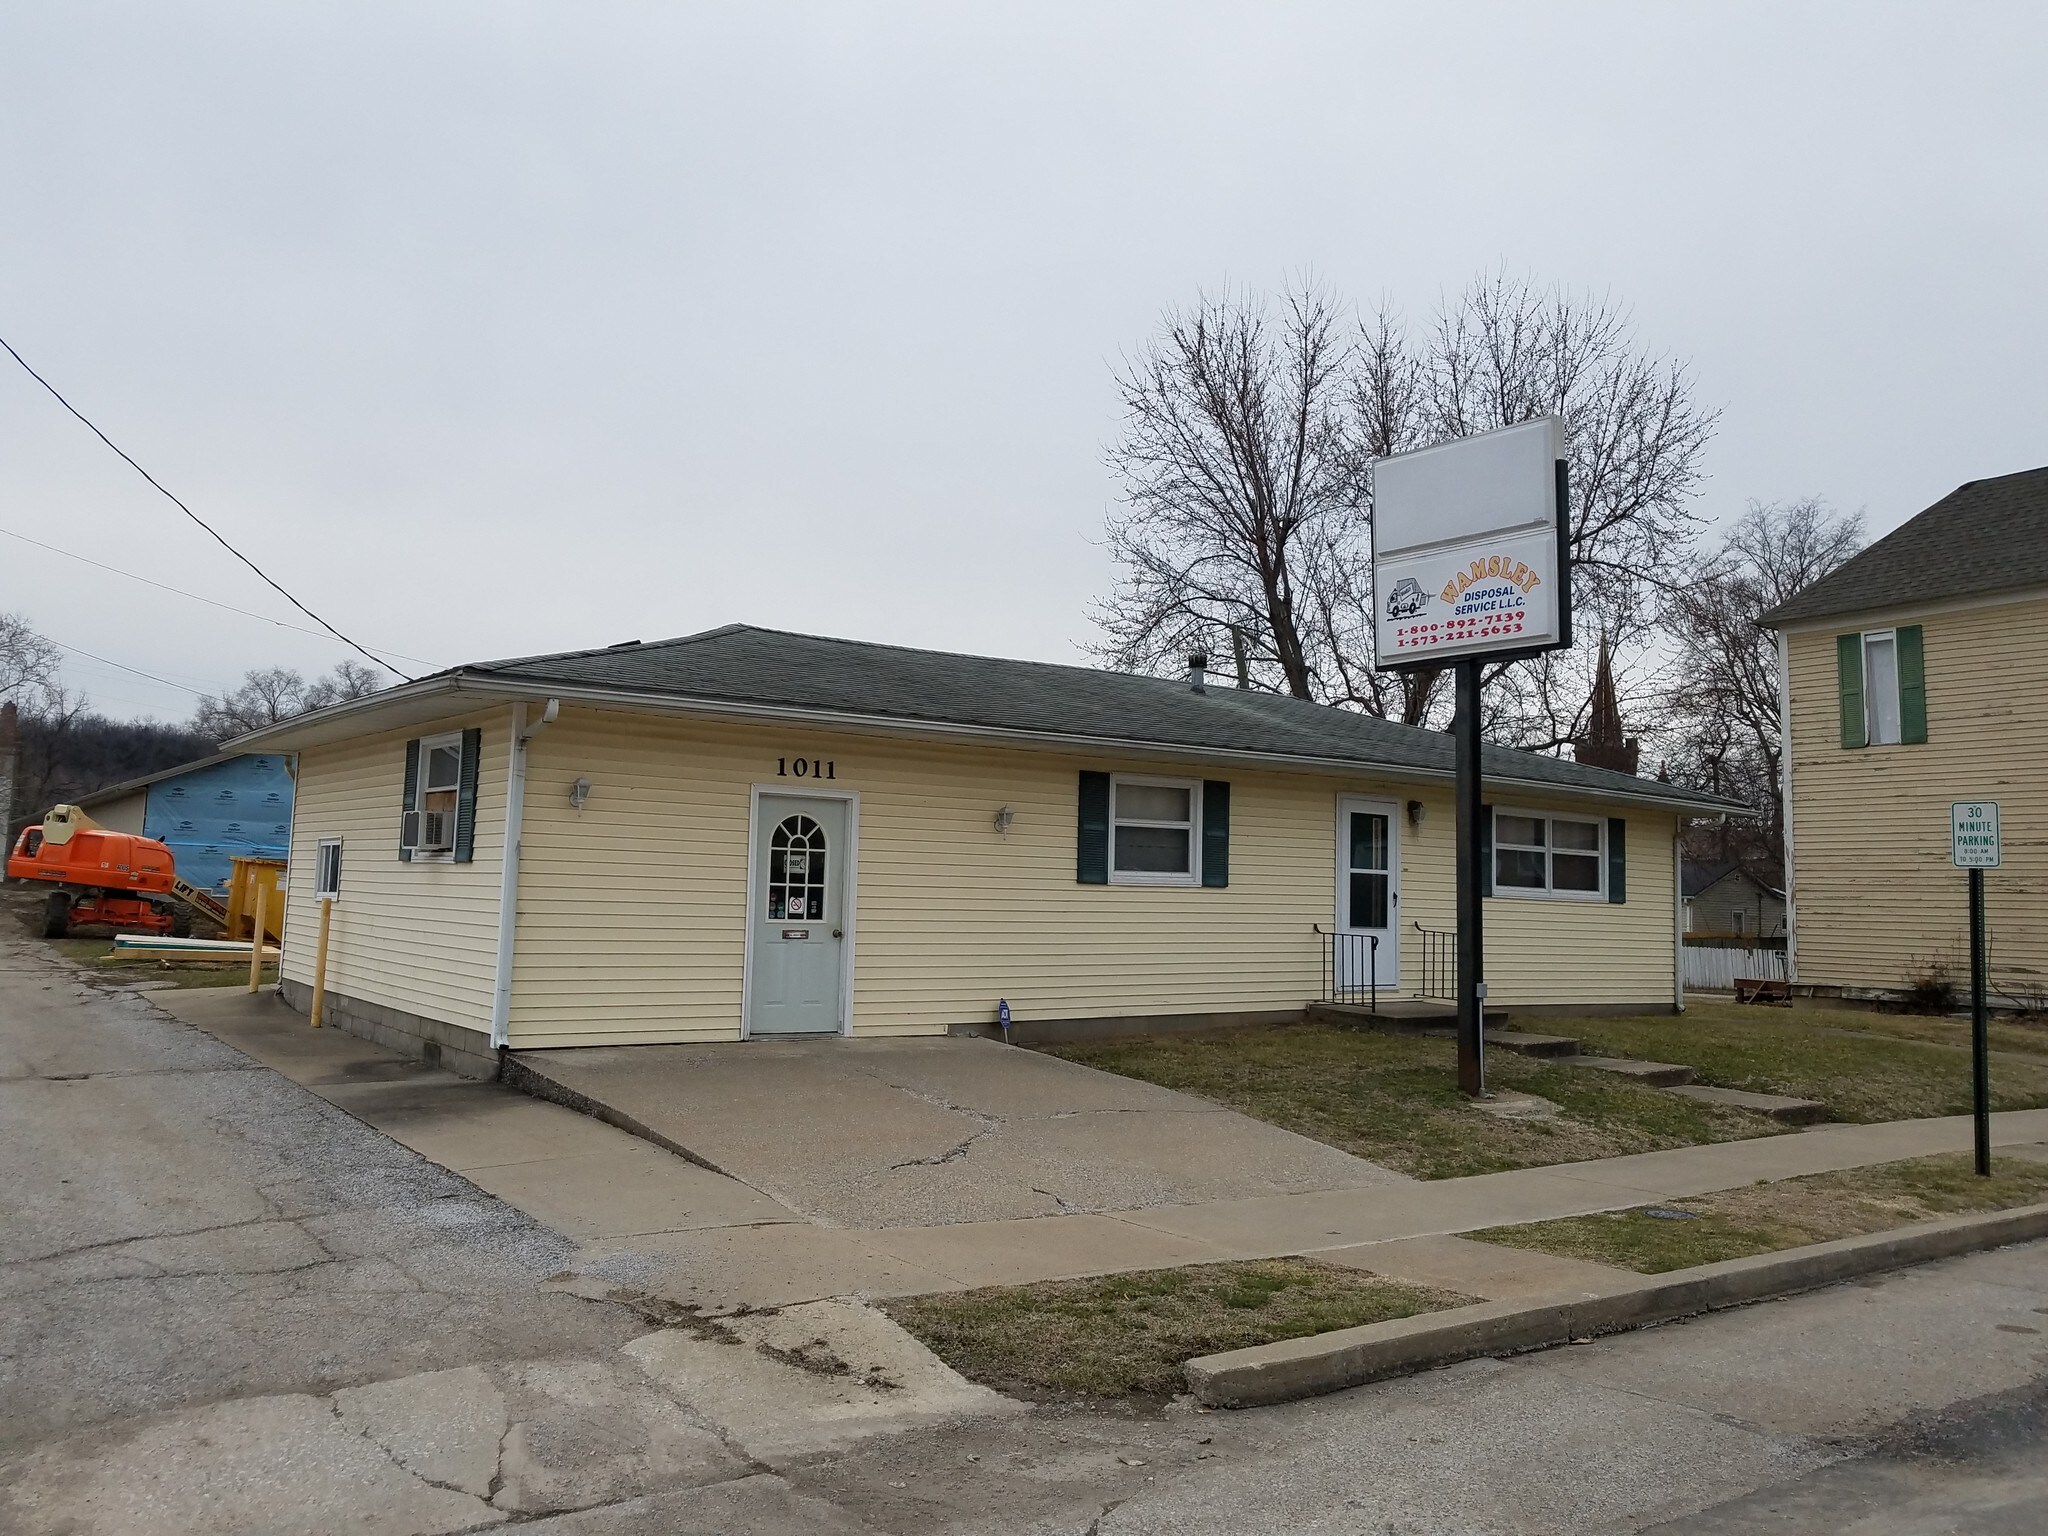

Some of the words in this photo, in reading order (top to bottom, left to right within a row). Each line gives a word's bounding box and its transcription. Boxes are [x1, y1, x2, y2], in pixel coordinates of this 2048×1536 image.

[1440, 556, 1541, 604] WAMSLEY
[1464, 586, 1515, 602] DISPOSAL
[1455, 601, 1497, 616] SERVICE
[1397, 611, 1525, 637] 1-800-892-7139
[1397, 623, 1523, 647] 1-573-221-5653
[777, 757, 836, 780] 1011
[1967, 807, 1982, 818] 30
[1959, 821, 1992, 832] MINUTE
[1957, 835, 1995, 846] PARKING
[174, 880, 195, 897] LIFT
